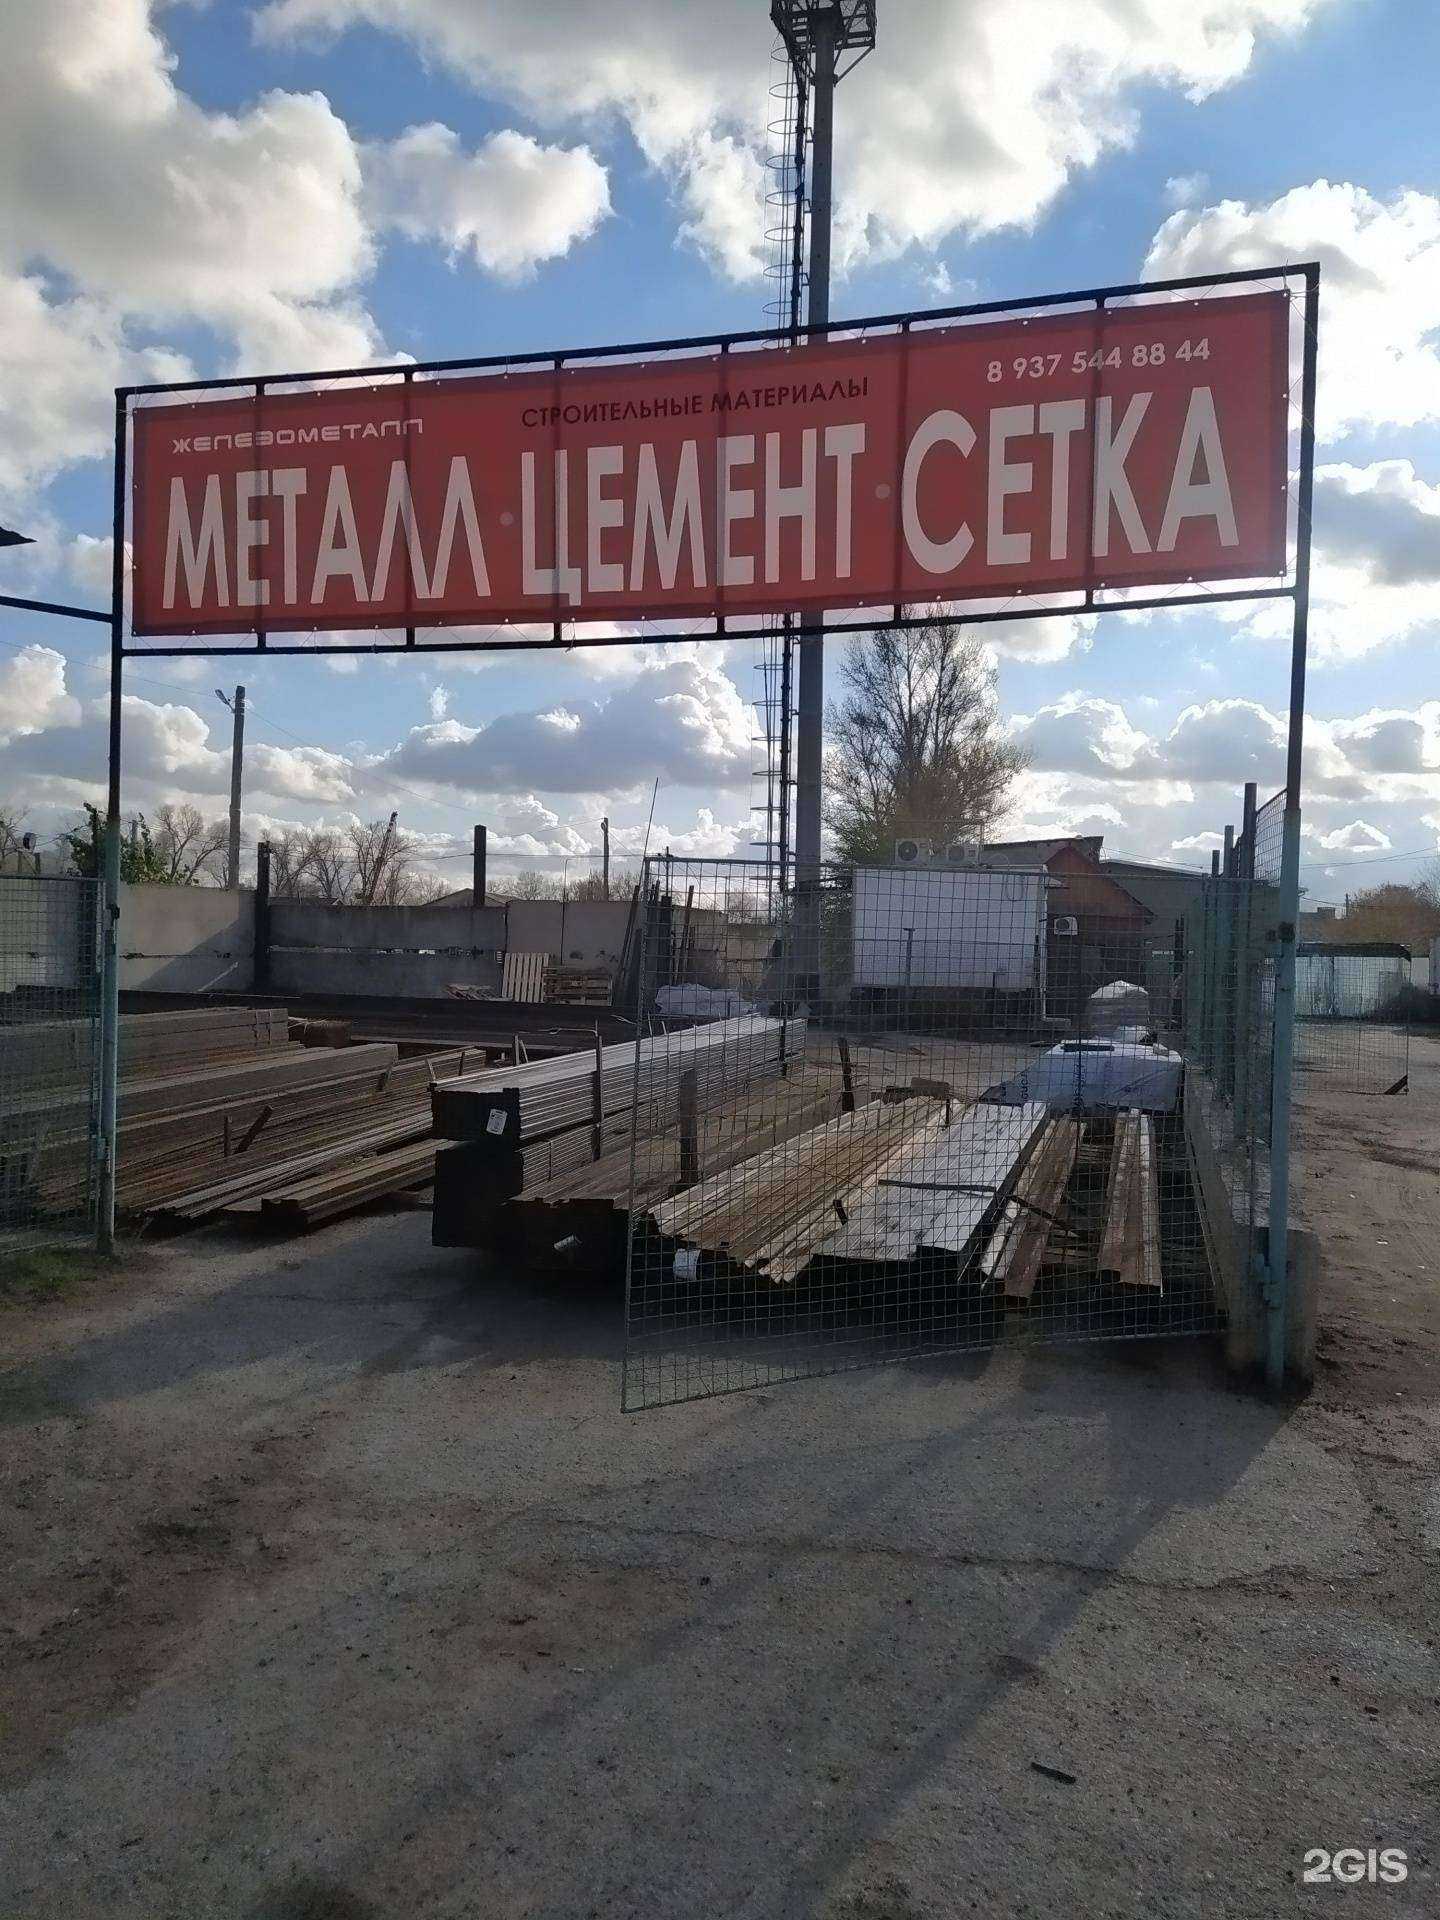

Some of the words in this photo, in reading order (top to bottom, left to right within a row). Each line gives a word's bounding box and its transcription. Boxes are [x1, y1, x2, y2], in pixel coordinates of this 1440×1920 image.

[987, 360, 1003, 383] 8
[1012, 354, 1062, 379] 937
[1071, 347, 1122, 373] 544
[1132, 342, 1166, 367] 88
[1175, 338, 1210, 362] 44
[521, 395, 703, 427] СТРОИТЕЛЬНЫЕ
[710, 376, 869, 412] МАТЕРИАЛЫ
[162, 456, 492, 609] МЕТАЛЛ
[521, 422, 866, 606] ЦЕМЕНТ
[902, 386, 1240, 574] СЕТКА
